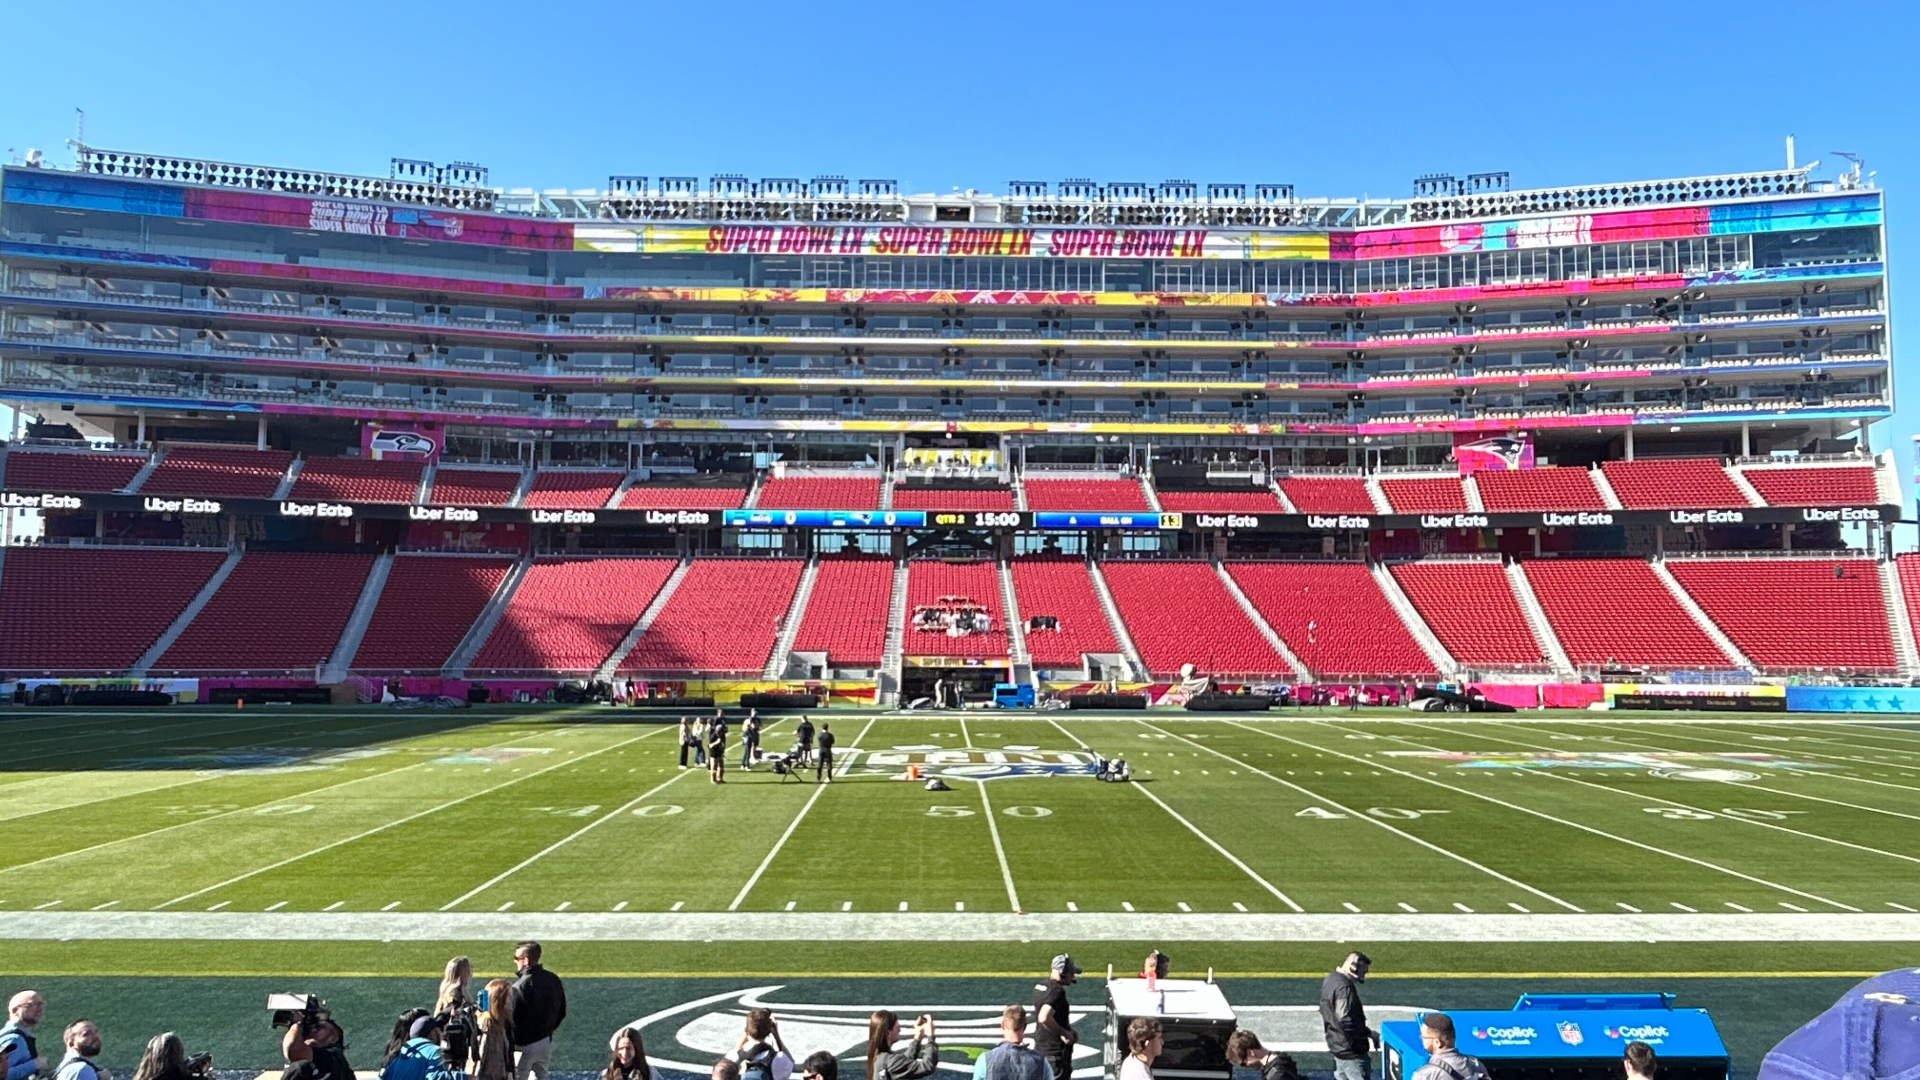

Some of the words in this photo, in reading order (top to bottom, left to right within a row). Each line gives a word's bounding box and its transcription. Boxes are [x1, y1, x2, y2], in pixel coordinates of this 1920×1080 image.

[310, 206, 344, 220] SUPER
[345, 210, 373, 224] BOWL
[705, 225, 774, 254] SUPER
[777, 226, 836, 254] BOWL
[838, 226, 867, 254] LX
[875, 227, 944, 255] SUPER
[947, 228, 1004, 255] BOWL
[1009, 228, 1036, 256] LX
[1049, 228, 1117, 256] SUPER
[1119, 229, 1177, 256] BOWL
[1180, 230, 1208, 257] LX
[1, 493, 40, 508] Uber
[41, 494, 81, 509] Eats
[144, 498, 182, 511] Uber
[183, 500, 220, 513] Eats
[280, 502, 315, 516] Uber
[317, 503, 353, 518] Eats
[409, 505, 443, 520] Uber
[445, 507, 479, 521] Eats
[531, 510, 562, 523] Uber
[564, 510, 596, 523] Eats
[1670, 511, 1705, 523] Uber
[1706, 510, 1743, 523] Eats
[1803, 509, 1840, 521] Uber
[1841, 508, 1880, 520] Eats
[646, 511, 676, 523] Uber
[678, 511, 709, 524] Eats
[935, 514, 957, 525] QTR
[957, 514, 965, 524] 2
[975, 512, 1020, 526] 15:00
[1163, 515, 1180, 526] 13
[1196, 515, 1226, 527] Uber
[1227, 515, 1258, 527] Eats
[1307, 515, 1338, 528] Uber
[1339, 515, 1370, 528] Eats
[1421, 515, 1453, 527] Uber
[1454, 515, 1488, 527] Eats
[1543, 513, 1576, 525] Uber
[1578, 513, 1613, 525] Eats
[1424, 539, 1444, 552] NFL
[1486, 1026, 1538, 1040] Copilot
[1563, 1031, 1581, 1041] NFL
[1619, 1025, 1669, 1039] Copilot
